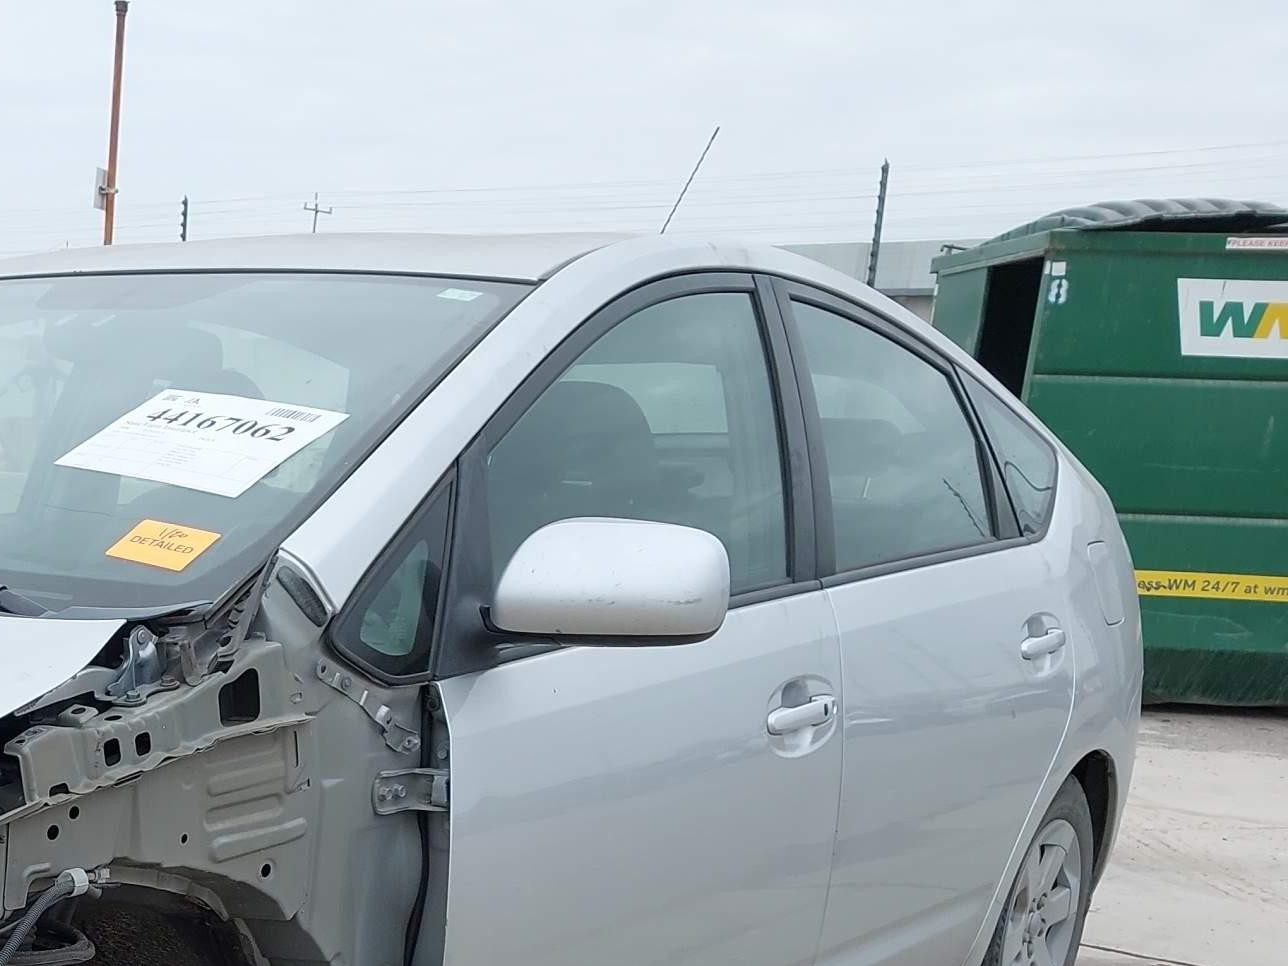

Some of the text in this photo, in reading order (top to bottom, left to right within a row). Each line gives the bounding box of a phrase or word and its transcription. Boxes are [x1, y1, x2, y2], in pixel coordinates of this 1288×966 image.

[146, 408, 295, 441] 44167062
[130, 535, 195, 554] DETAILED
[1168, 578, 1196, 590] WM
[1201, 580, 1240, 593] 24/7
[1244, 584, 1258, 593] at
